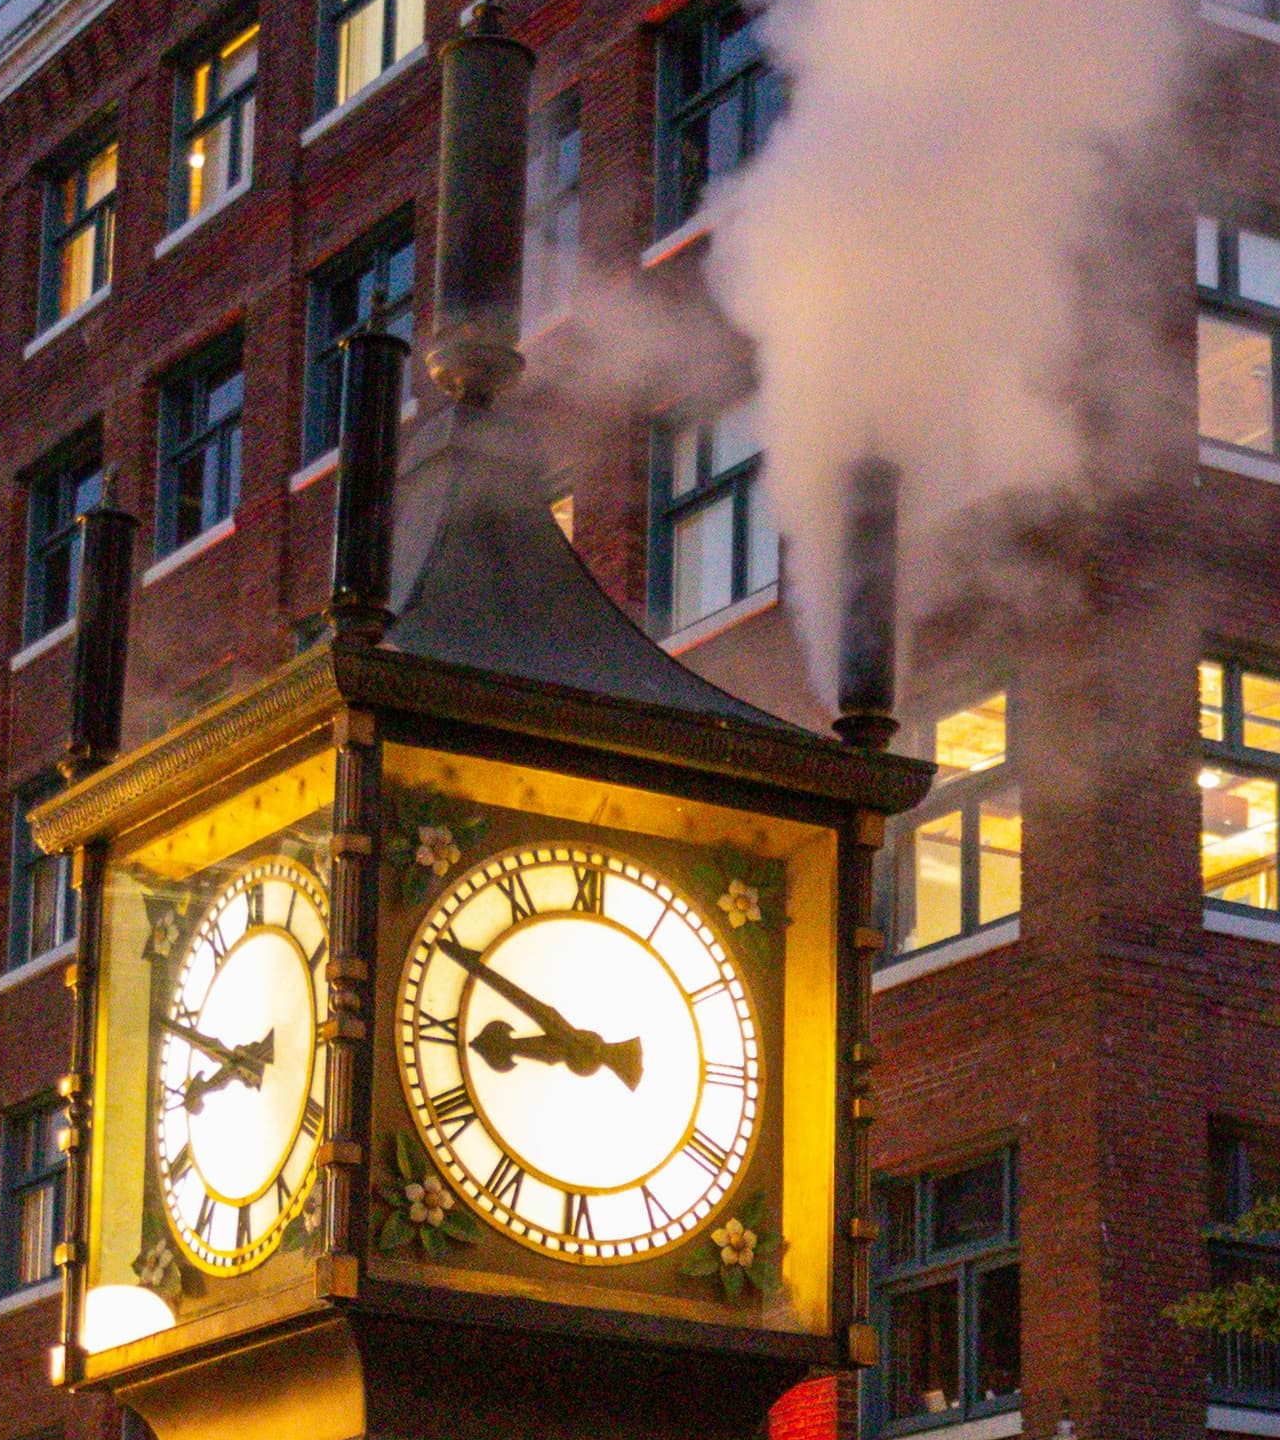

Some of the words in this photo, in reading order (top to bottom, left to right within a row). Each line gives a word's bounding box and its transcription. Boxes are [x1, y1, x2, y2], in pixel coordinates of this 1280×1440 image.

[496, 875, 536, 924] XI
[571, 864, 605, 916] XII
[689, 979, 729, 1004] II
[417, 1011, 459, 1044] IX
[705, 1062, 746, 1088] III
[486, 1154, 524, 1211] VII
[565, 1192, 595, 1240] VI
